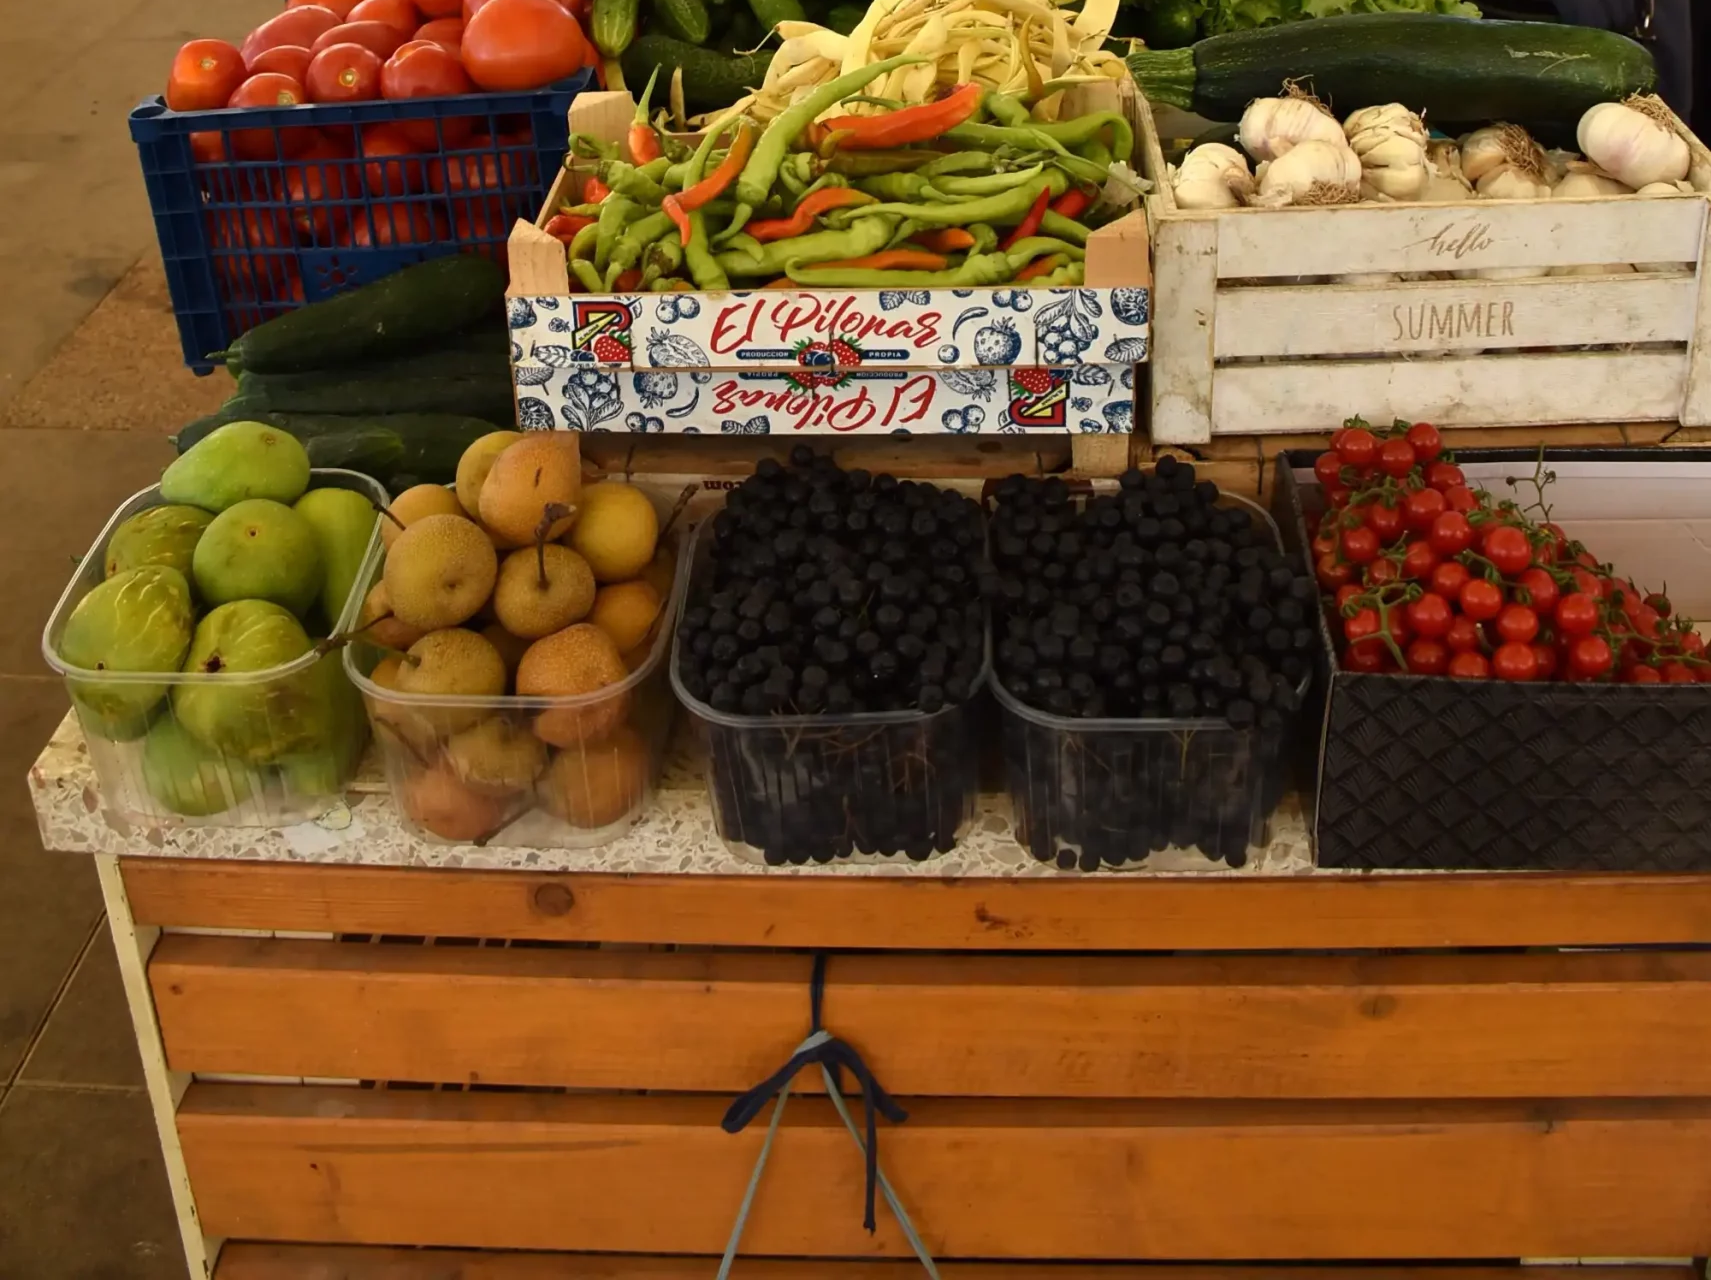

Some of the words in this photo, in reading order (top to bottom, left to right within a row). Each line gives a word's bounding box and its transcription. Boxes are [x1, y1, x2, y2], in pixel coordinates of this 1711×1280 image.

[1402, 222, 1495, 259] hello
[710, 299, 766, 354] El
[1393, 301, 1514, 341] SUMMER
[880, 374, 937, 426] El
